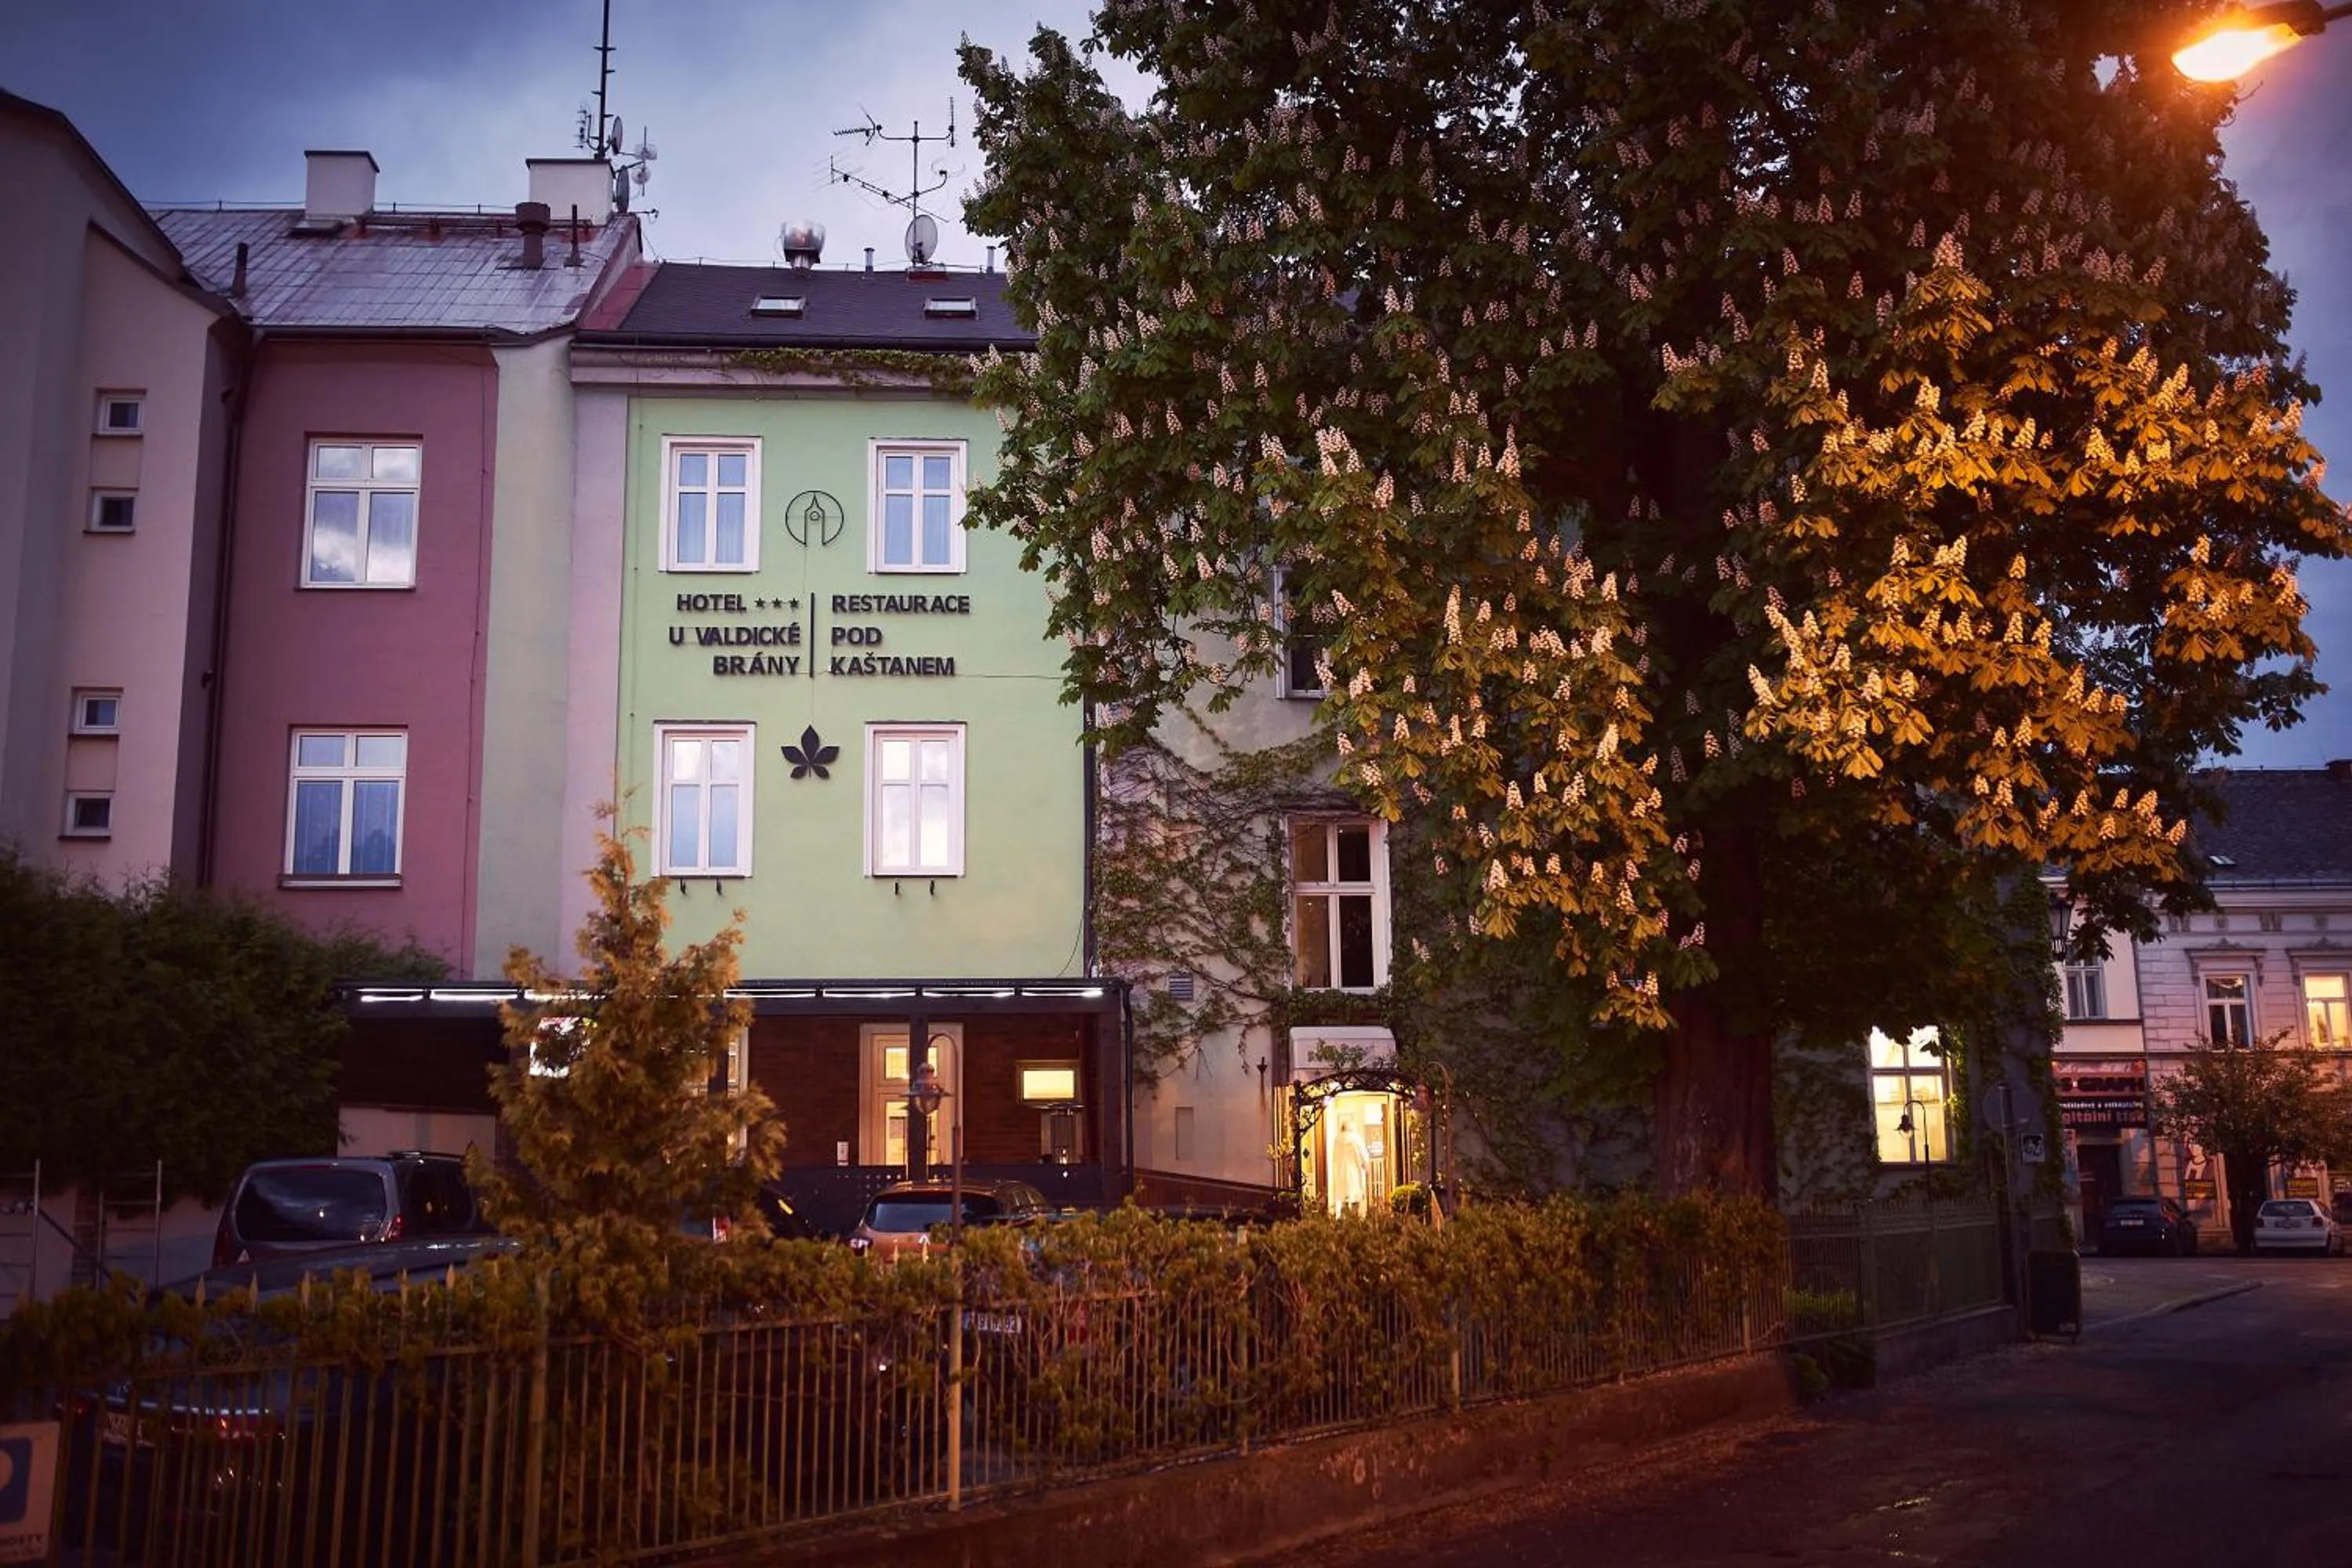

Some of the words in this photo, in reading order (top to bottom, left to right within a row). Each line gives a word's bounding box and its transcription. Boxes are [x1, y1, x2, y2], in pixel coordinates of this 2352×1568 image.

[677, 593, 747, 612] HOTEL
[832, 595, 970, 613] RESTAURACE
[669, 626, 684, 646] U
[696, 622, 800, 646] VALDICKÉ
[832, 626, 883, 646] POD
[713, 652, 800, 676] BRÁNY
[831, 652, 956, 677] KAŠTANEM
